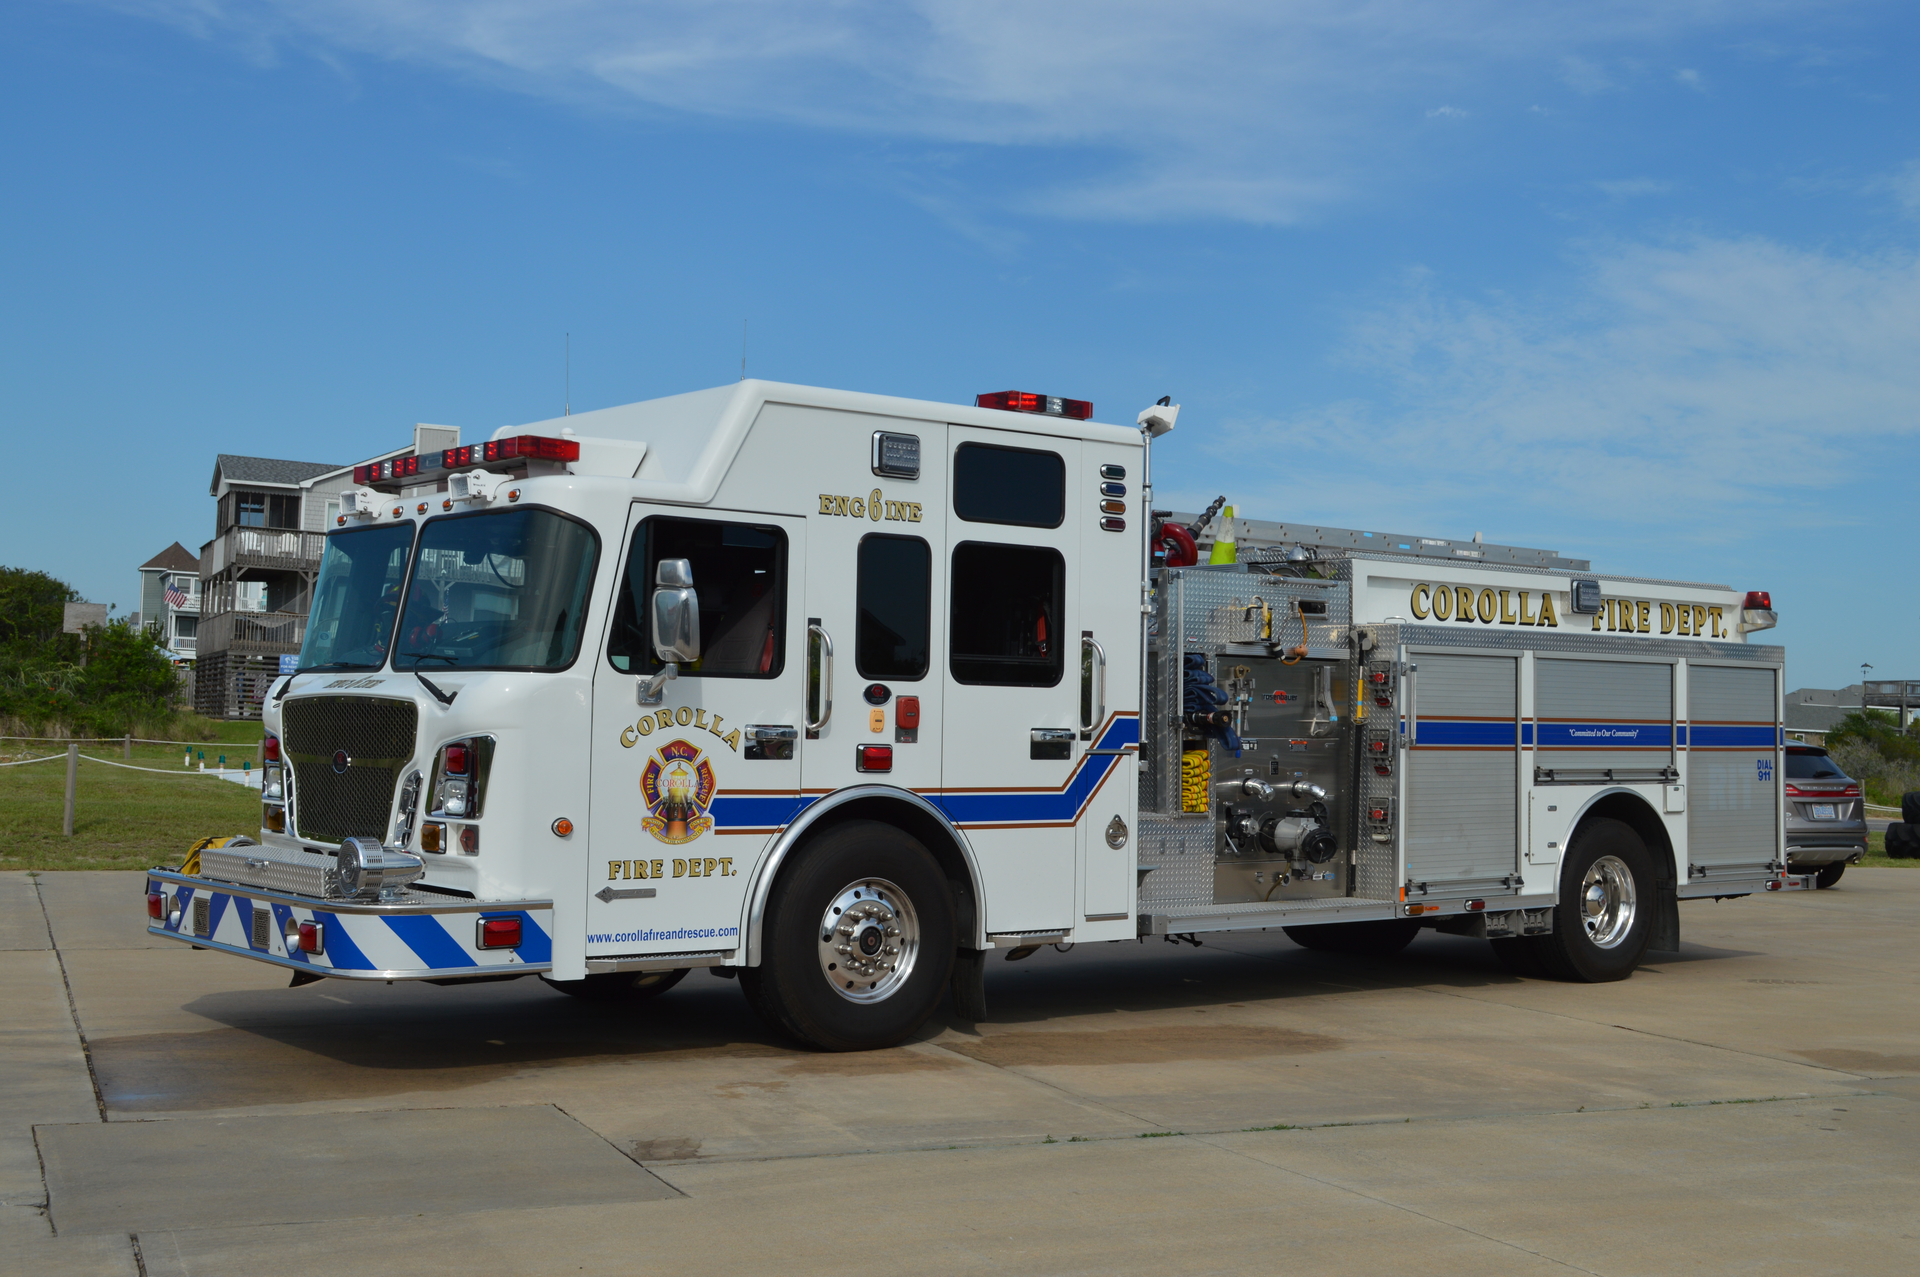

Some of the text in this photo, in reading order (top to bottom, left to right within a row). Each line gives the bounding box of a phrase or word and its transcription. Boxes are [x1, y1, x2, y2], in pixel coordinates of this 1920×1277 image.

[1410, 583, 1558, 627] COROLLA
[1659, 602, 1728, 639] DEPT.
[620, 706, 741, 752] COROLLA
[1601, 729, 1612, 737] Our
[670, 746, 688, 756] N.C.
[1757, 759, 1773, 770] DIAL
[646, 772, 656, 794] FIRE
[655, 778, 701, 788] COROLLA
[698, 768, 710, 802] RESCUE
[1757, 770, 1771, 781] 911
[608, 857, 737, 880] FIRE DEPT.
[587, 927, 738, 944] www.corollafireandrescue.com
